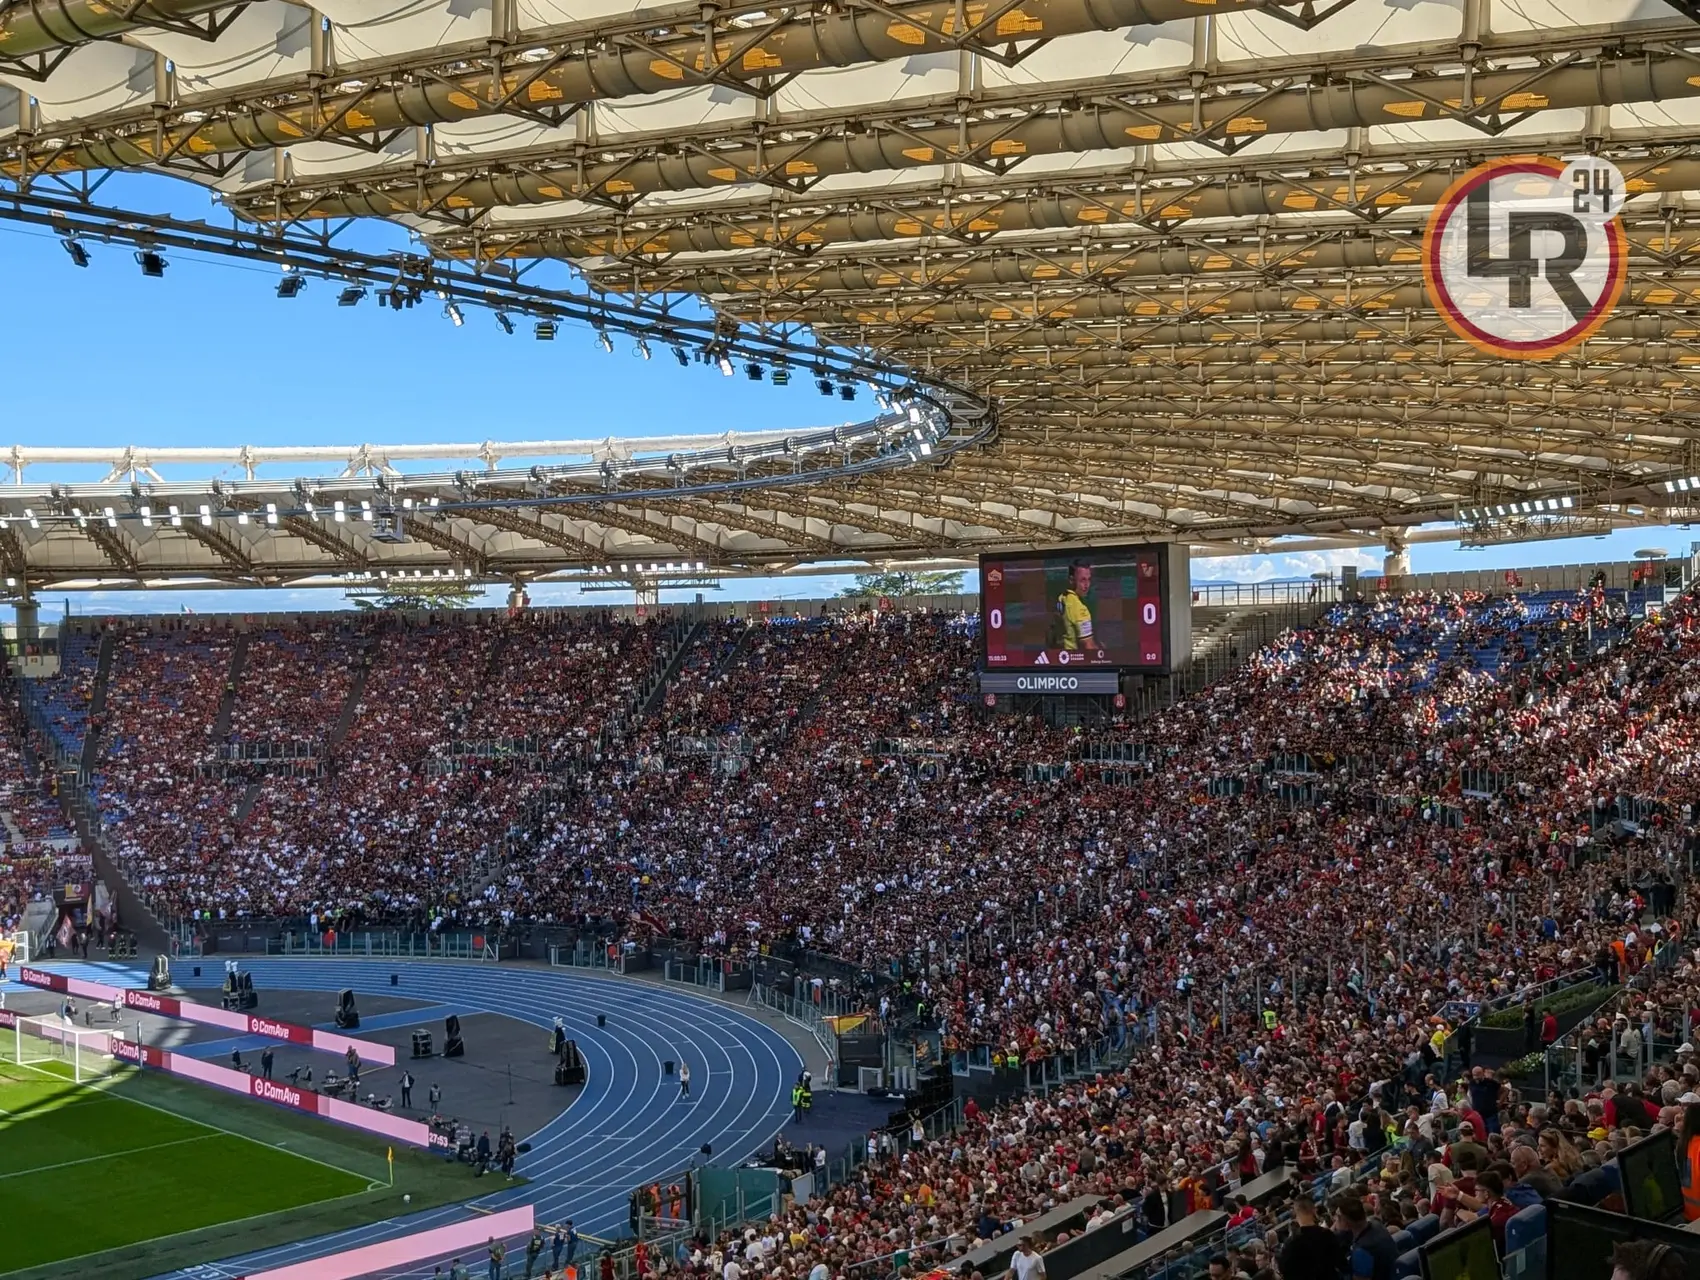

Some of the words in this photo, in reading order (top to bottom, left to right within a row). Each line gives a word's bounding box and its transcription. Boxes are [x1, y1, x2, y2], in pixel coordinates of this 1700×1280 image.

[990, 609, 1001, 629] 0
[1143, 603, 1156, 625] 0
[1017, 677, 1078, 690] OLIMPICO
[135, 993, 160, 1010] ComAve
[259, 1020, 289, 1039] ComAve
[264, 1082, 300, 1106] ComAve
[429, 1132, 449, 1148] 27:53
